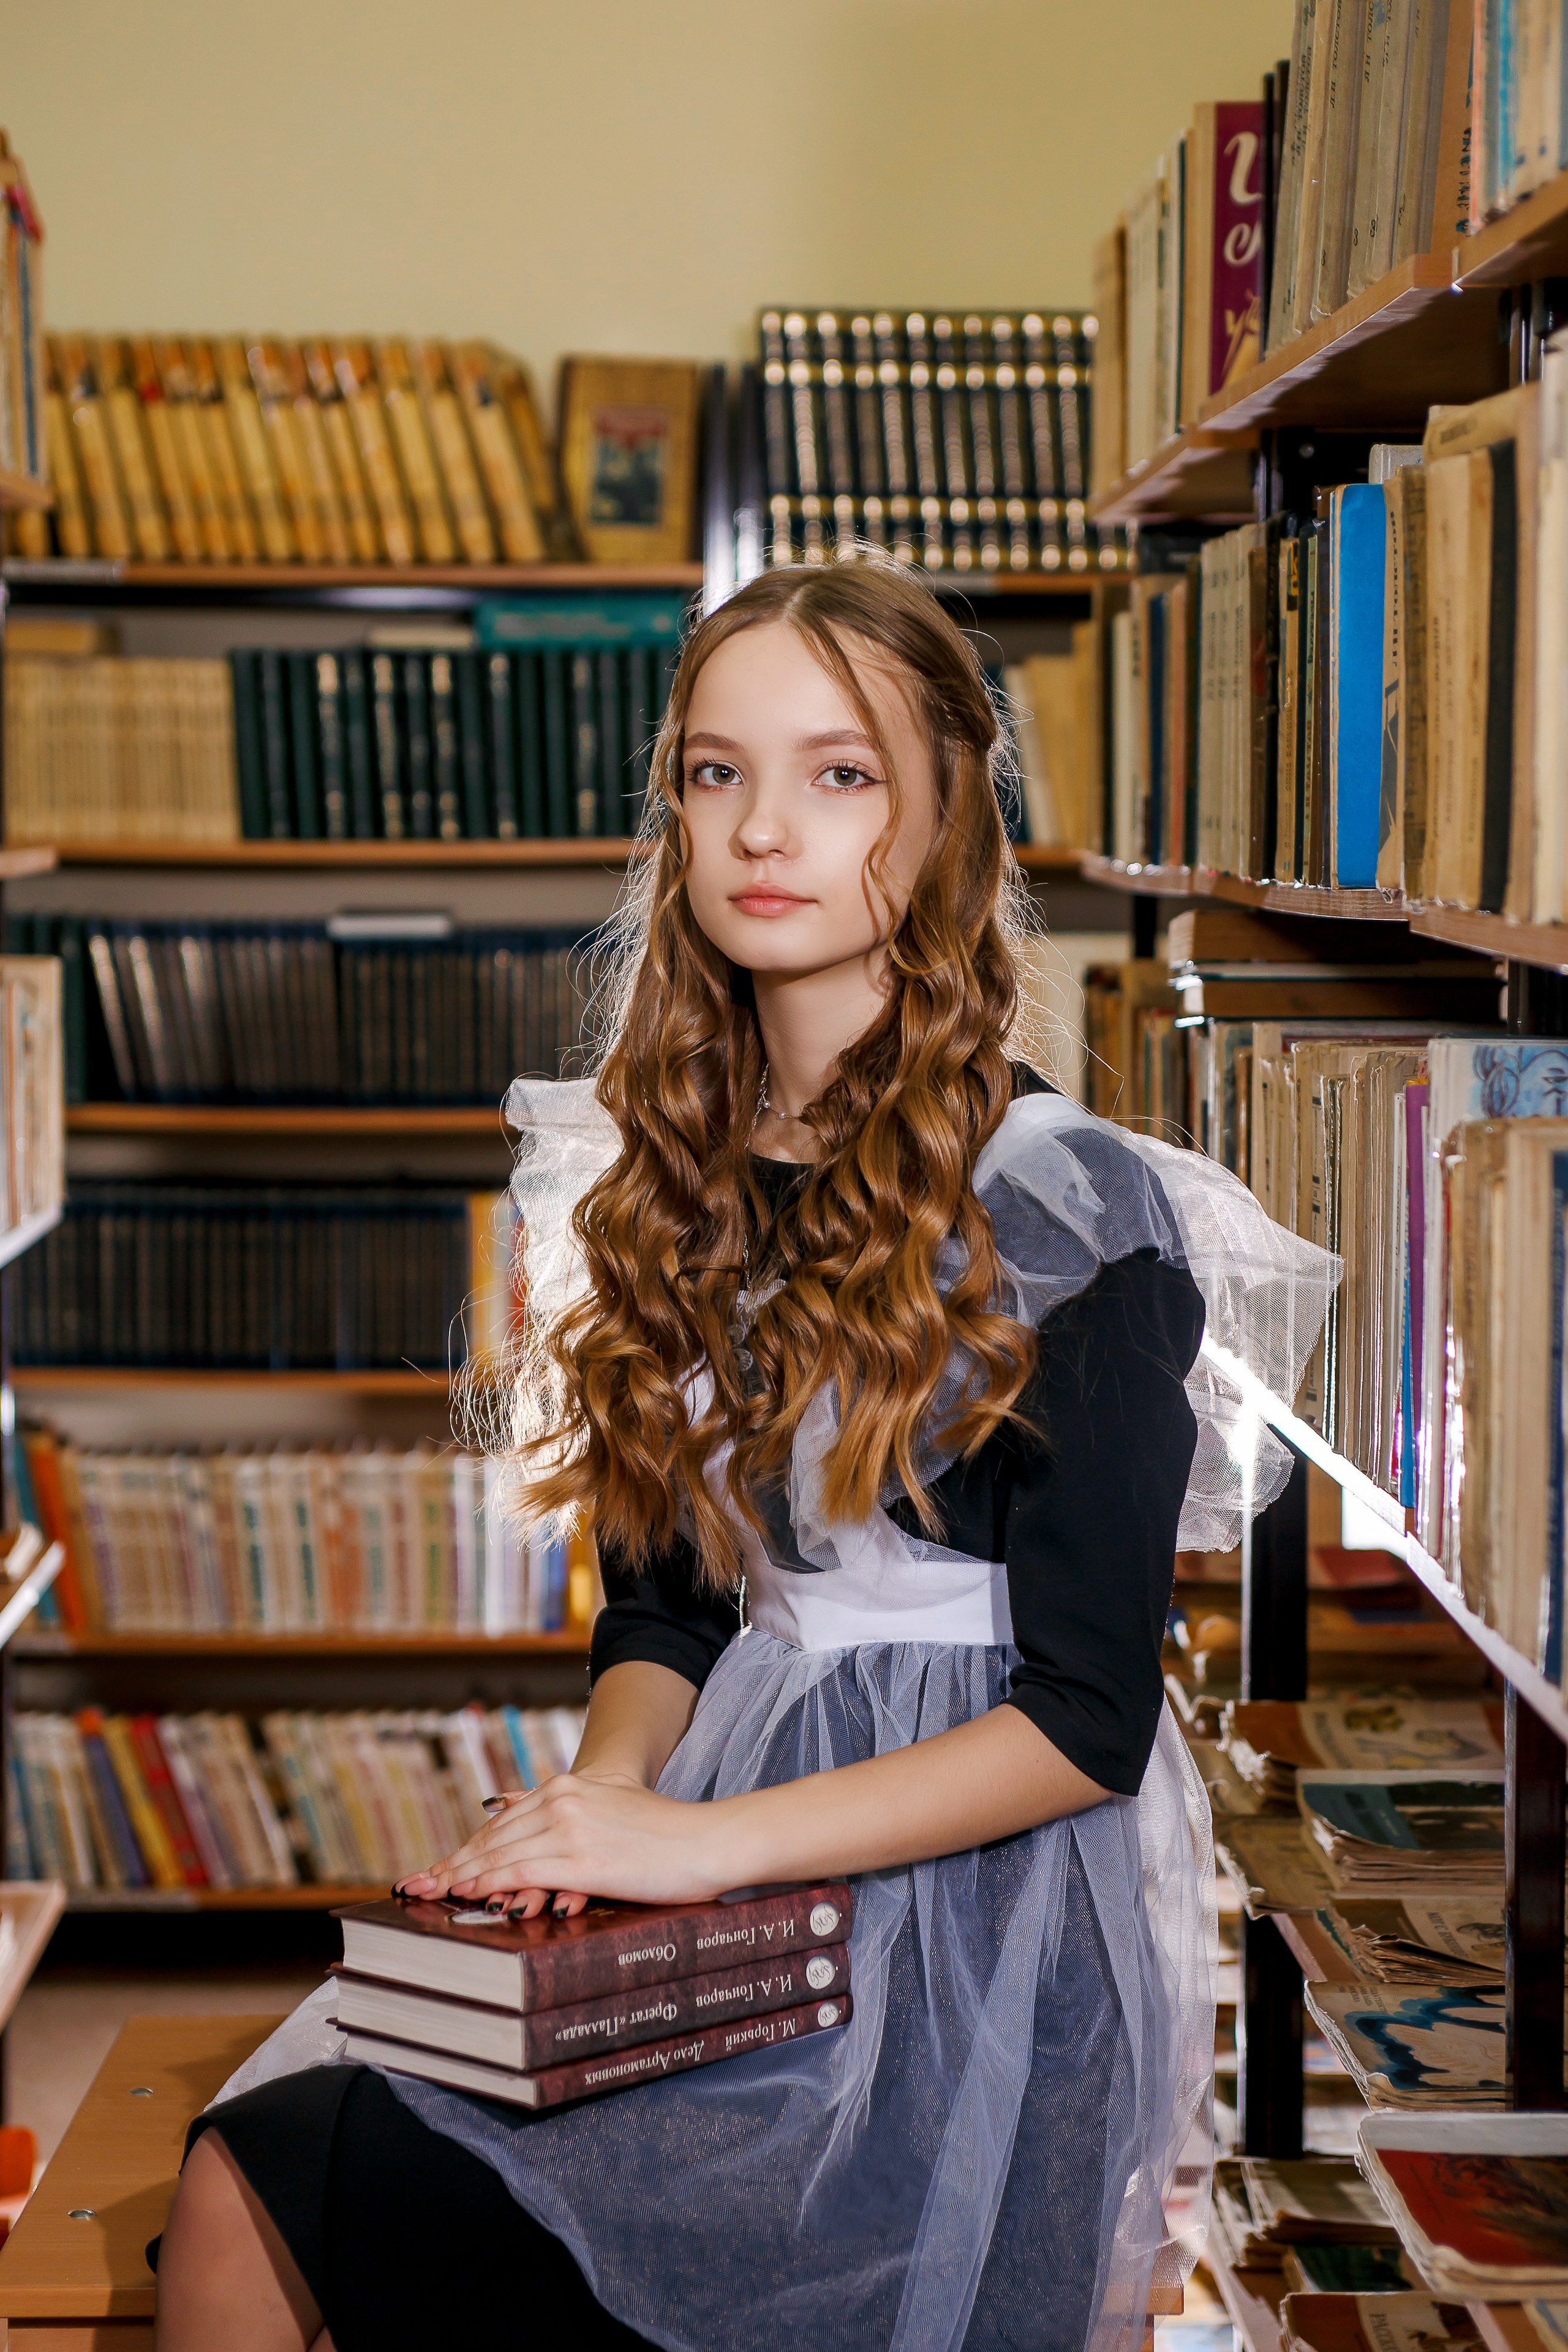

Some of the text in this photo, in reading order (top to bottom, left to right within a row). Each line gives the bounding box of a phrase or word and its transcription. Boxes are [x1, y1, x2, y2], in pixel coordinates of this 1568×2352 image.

[697, 1927, 755, 1950] Гончаров
[760, 1922, 775, 1941] А.
[778, 1919, 794, 1937] И.
[618, 1943, 676, 1966] Обломов
[756, 1978, 772, 1997] А.
[775, 1973, 792, 1993] И.
[696, 1983, 753, 2007] Гончаров
[555, 2002, 677, 2041] Фрегат «Паллада»
[725, 2018, 796, 2051] М. Горький
[584, 2039, 704, 2085] Дело Артамоновых
